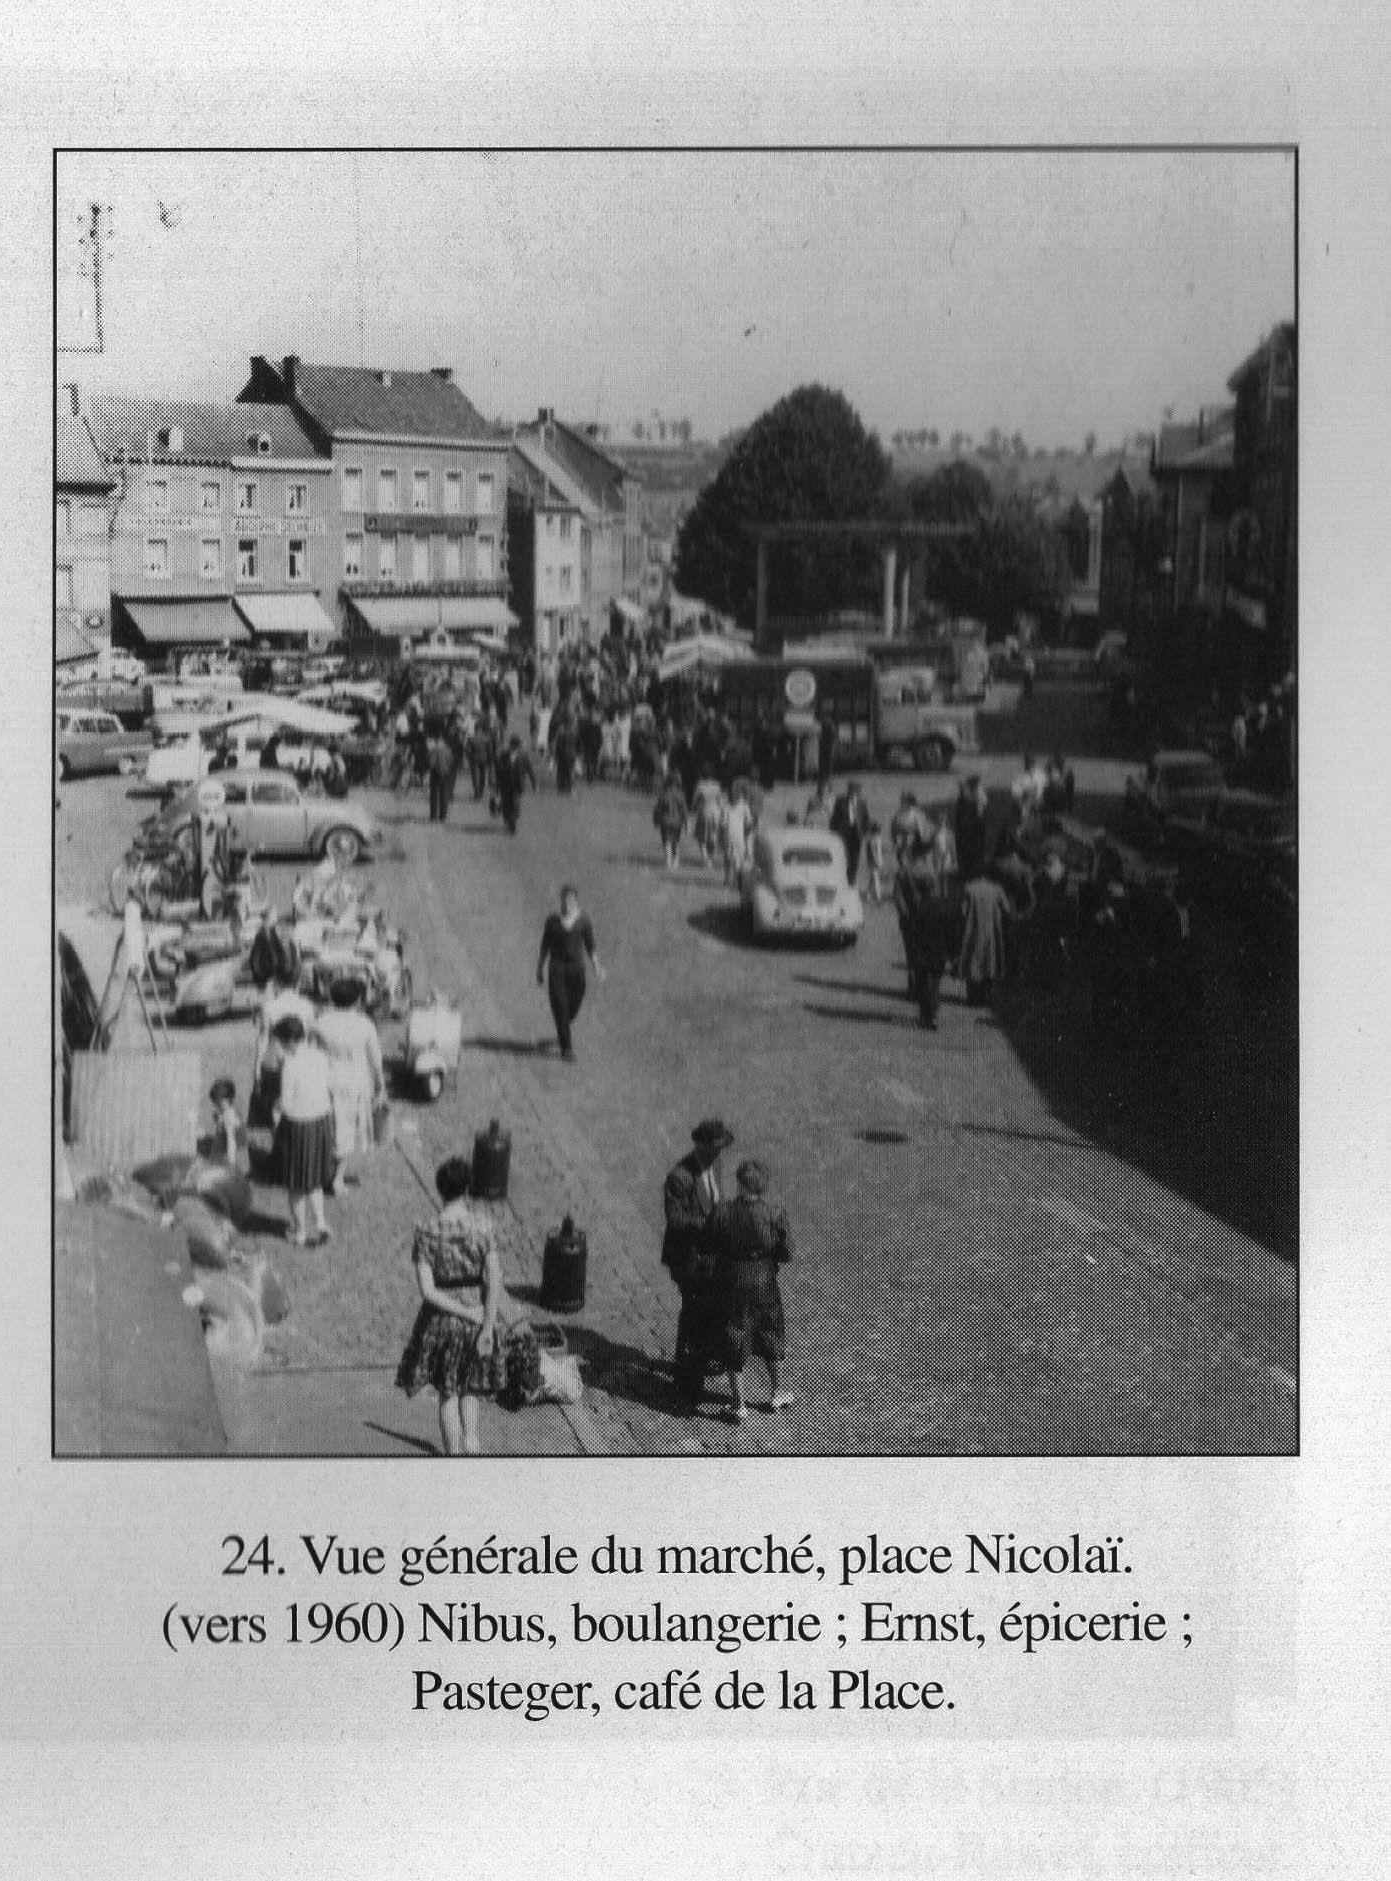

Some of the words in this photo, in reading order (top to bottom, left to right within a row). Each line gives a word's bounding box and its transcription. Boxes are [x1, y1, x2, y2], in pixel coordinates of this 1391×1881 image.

[221, 1534, 286, 1576] 24.
[300, 1534, 387, 1576] Vue
[398, 1533, 580, 1588] générale
[590, 1533, 645, 1576] du
[656, 1532, 826, 1582] marché,
[838, 1532, 954, 1587] place
[964, 1532, 1133, 1575] Nicolaï.
[162, 1602, 268, 1655] (vers
[288, 1601, 406, 1653] 1960)
[416, 1601, 558, 1651] Nibus,
[569, 1600, 823, 1655] boulangerie
[860, 1601, 987, 1650] Ernst,
[998, 1600, 1168, 1654] épicerie
[410, 1669, 602, 1723] Pasteger,
[613, 1668, 703, 1711] café
[713, 1668, 766, 1711] de
[777, 1668, 818, 1711] la
[827, 1668, 956, 1711] Place.
